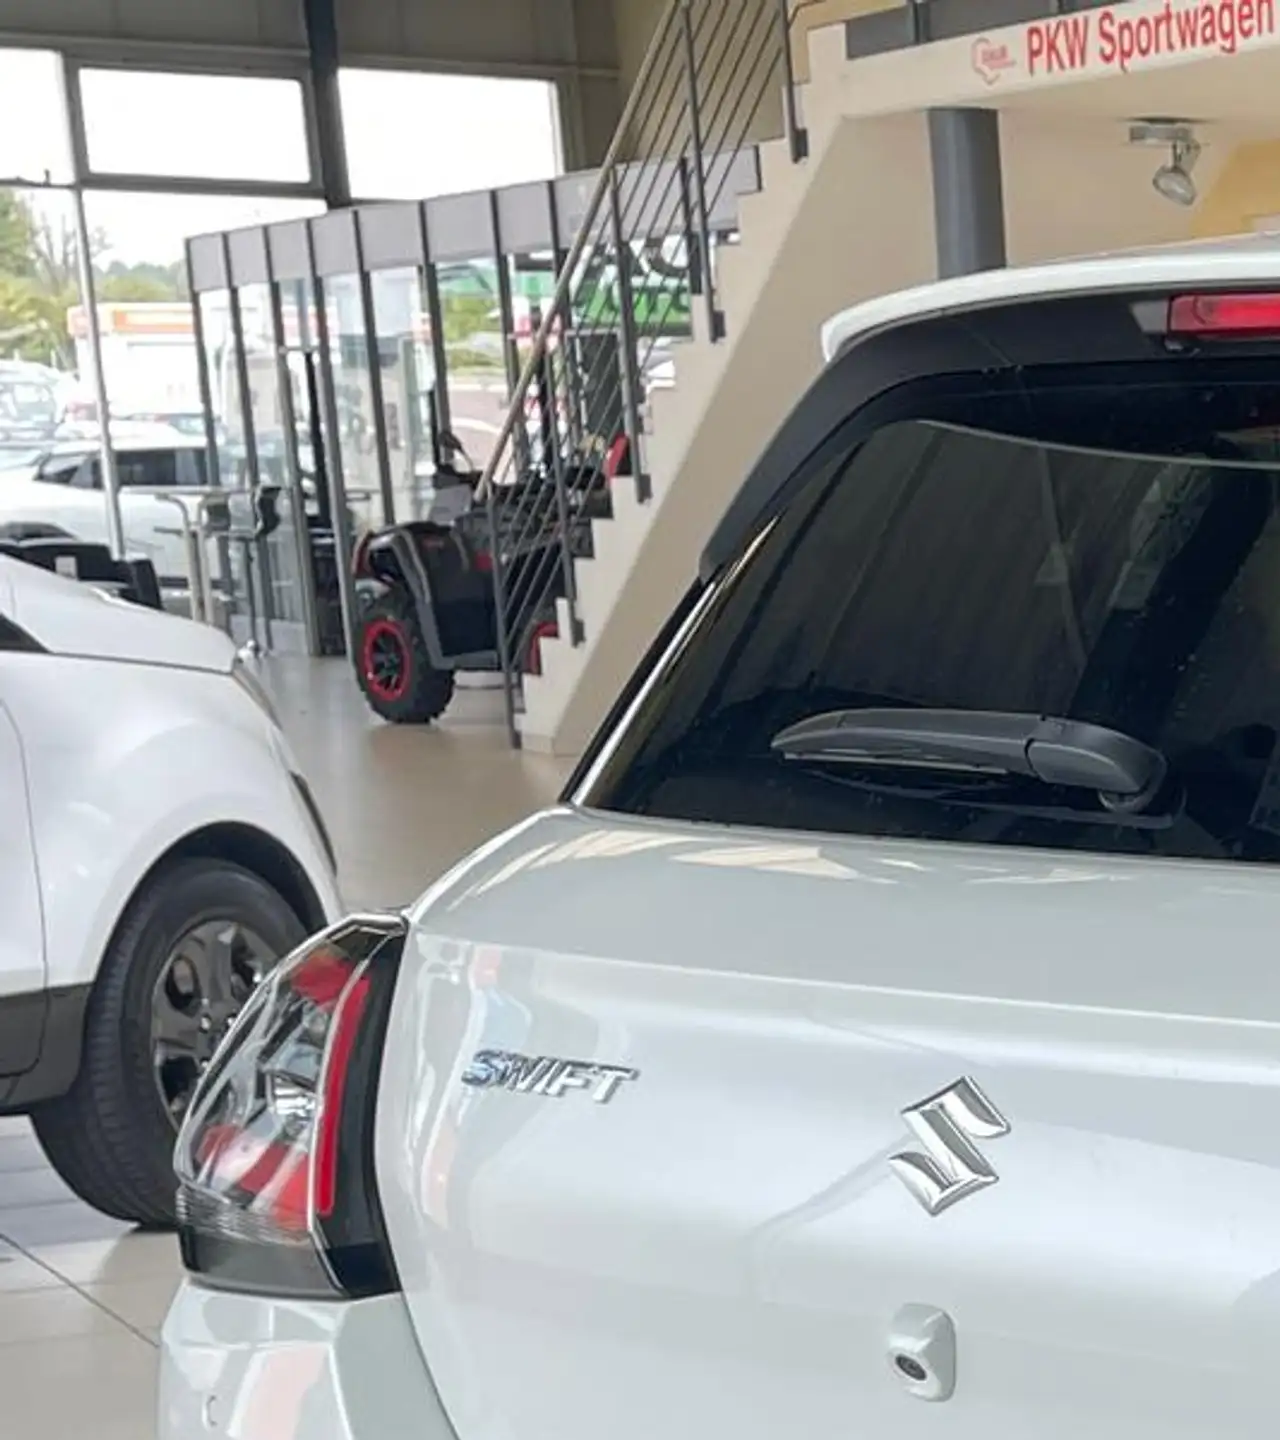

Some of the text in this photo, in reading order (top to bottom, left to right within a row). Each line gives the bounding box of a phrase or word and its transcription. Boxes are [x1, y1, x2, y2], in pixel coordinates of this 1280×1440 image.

[1026, 15, 1090, 76] PKW
[1099, 0, 1275, 73] Sportwagen
[460, 1048, 642, 1105] SWIFT
